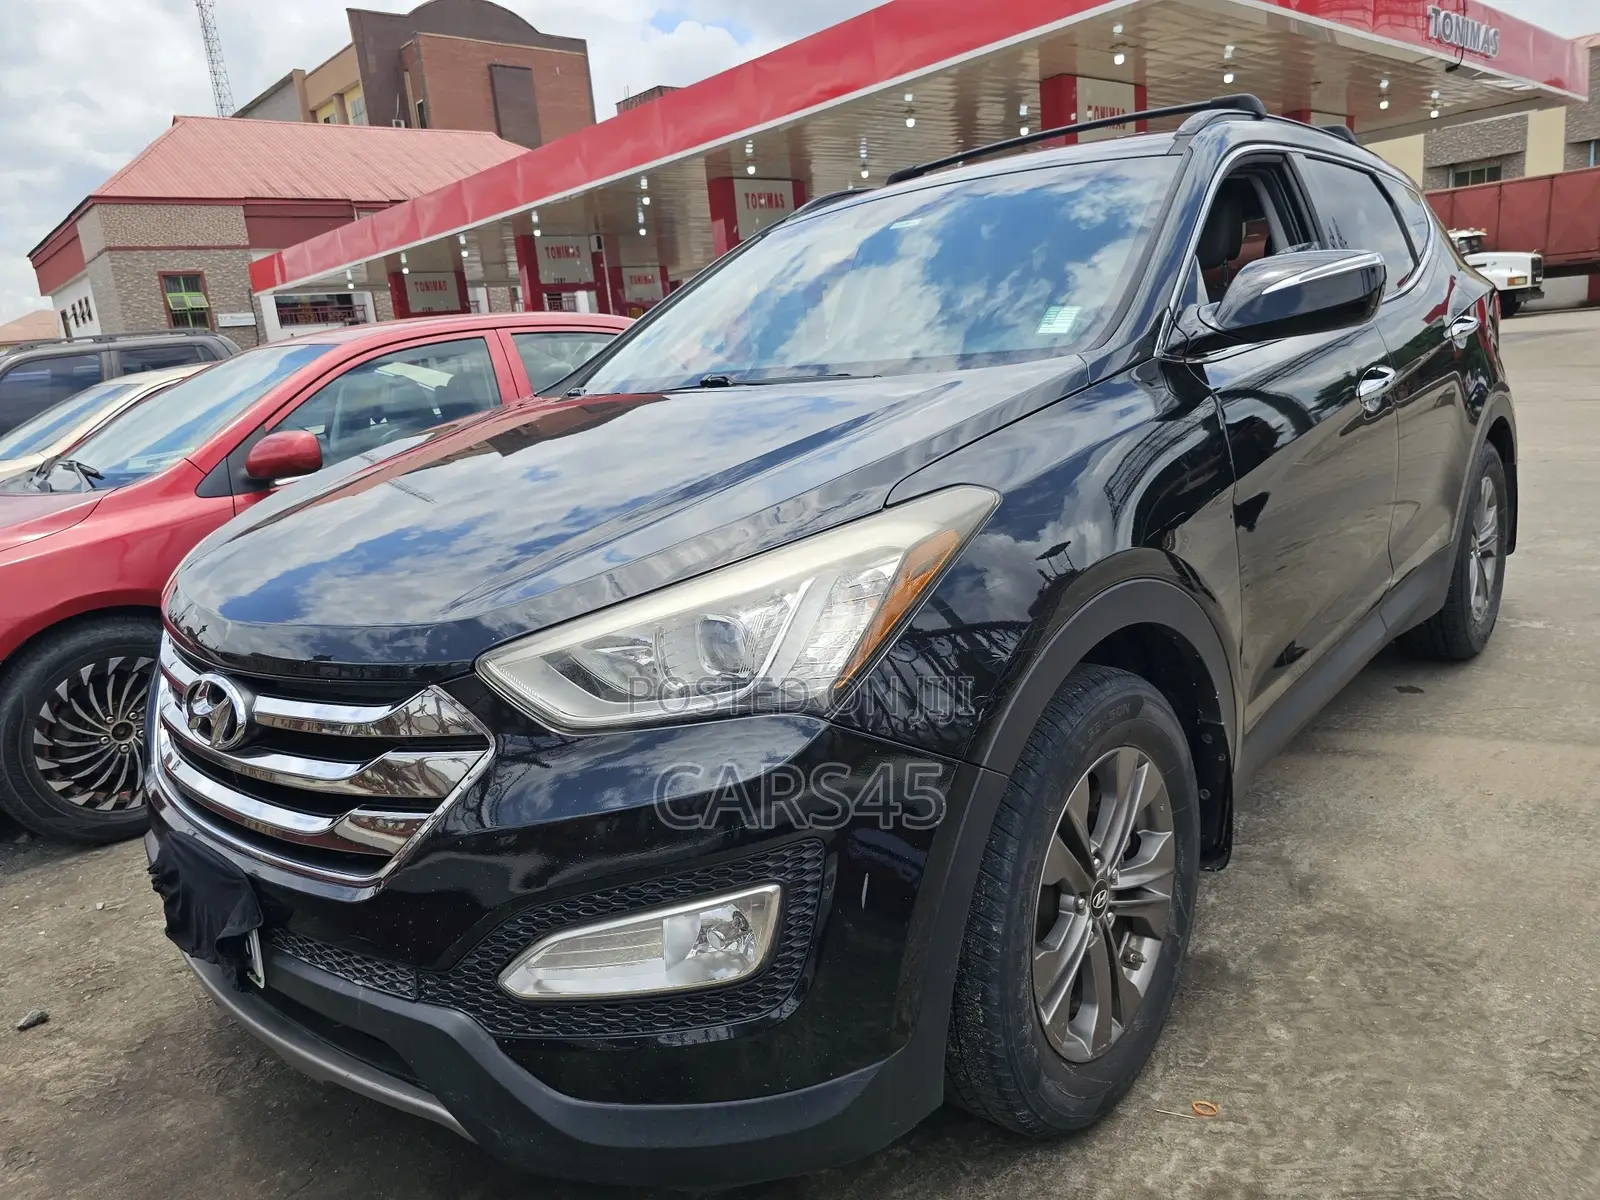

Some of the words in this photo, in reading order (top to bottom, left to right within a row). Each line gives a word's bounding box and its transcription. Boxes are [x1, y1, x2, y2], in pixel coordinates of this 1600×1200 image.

[1427, 5, 1500, 57] TONIMAS
[744, 192, 785, 210] TONIMAS
[545, 245, 581, 259] TONIMAS
[414, 281, 448, 292] TONIMAS
